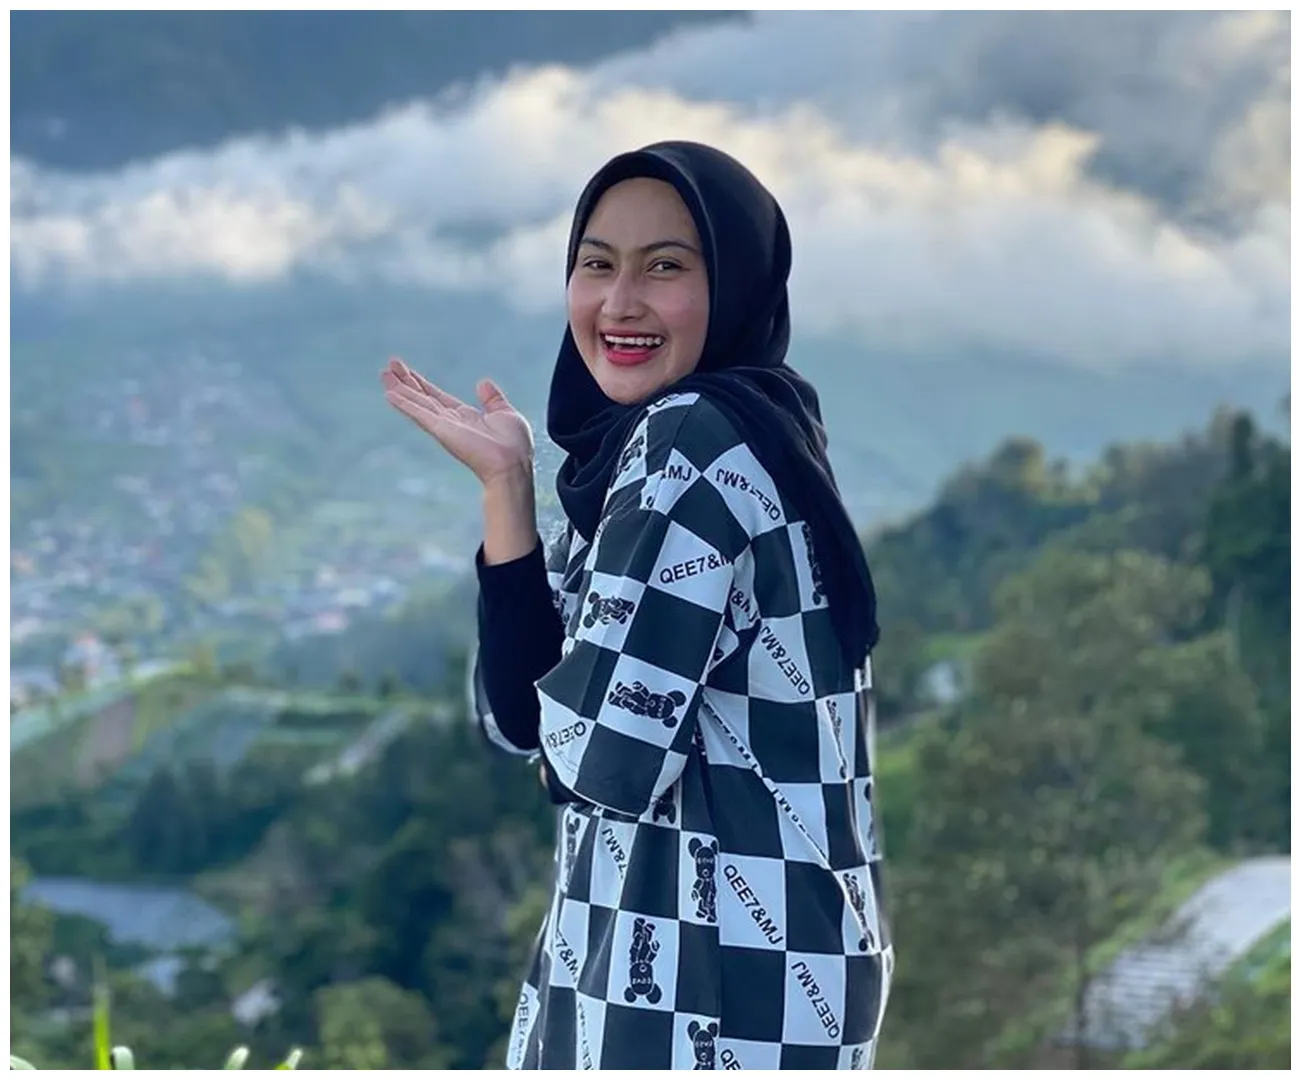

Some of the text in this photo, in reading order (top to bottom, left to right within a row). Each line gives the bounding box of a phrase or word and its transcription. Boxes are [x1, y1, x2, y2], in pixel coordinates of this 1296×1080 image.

[761, 626, 811, 695] QEE7&MJ
[602, 828, 626, 878] 7&MJ
[723, 864, 784, 945] QEE7&MJ
[791, 961, 840, 1039] QEE7&MJ
